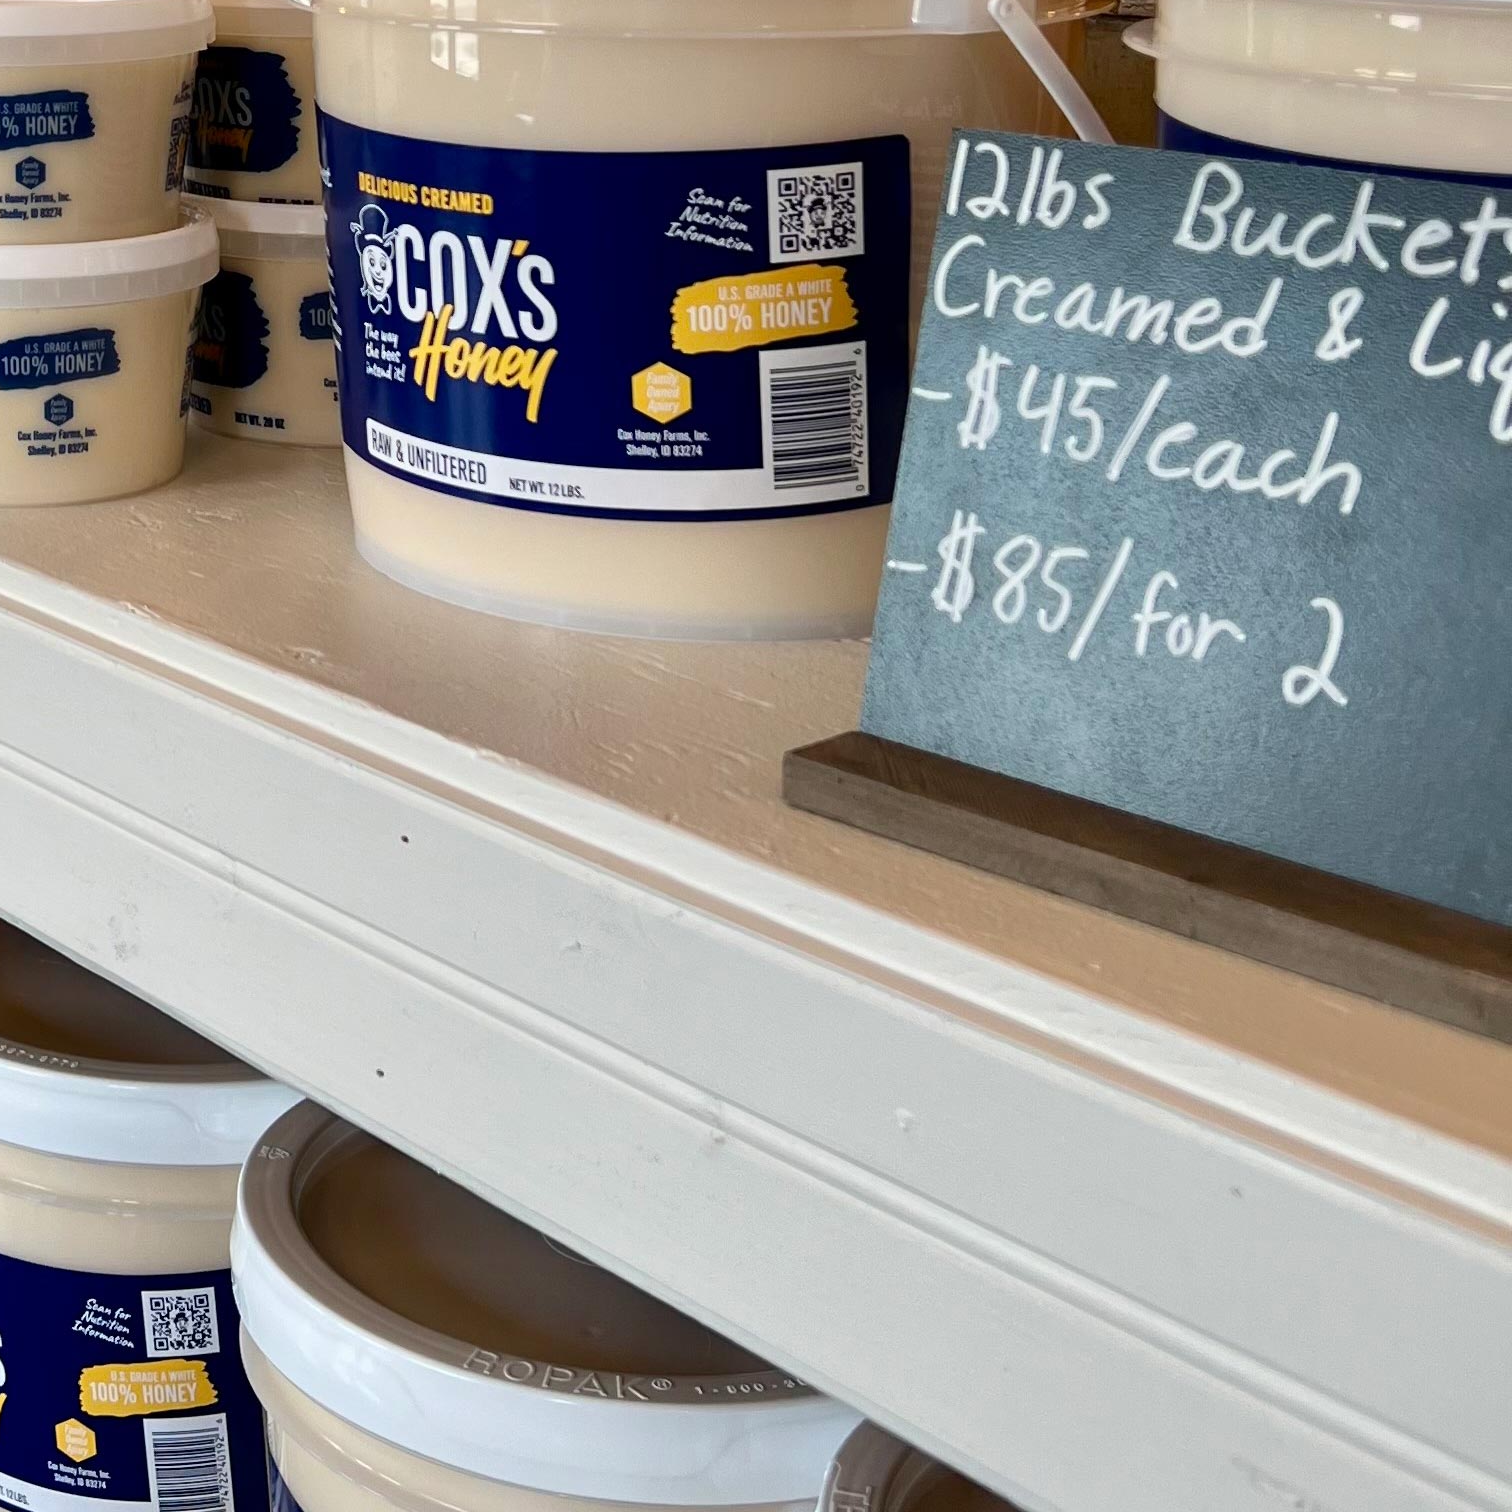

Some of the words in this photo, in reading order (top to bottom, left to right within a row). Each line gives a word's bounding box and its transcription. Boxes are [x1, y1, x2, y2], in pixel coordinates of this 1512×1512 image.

[14, 102, 42, 114] GRADE
[44, 102, 51, 114] A
[53, 101, 79, 113] WHITE
[25, 114, 79, 136] HONEY
[358, 171, 419, 206] DELICIOUS
[420, 185, 495, 216] CREAMED
[945, 138, 1115, 231] 12lbs
[686, 187, 725, 209] Scan
[727, 196, 752, 214] for
[678, 206, 749, 233] Nutrition
[664, 221, 754, 253] Information
[394, 223, 558, 343] COX'S
[718, 285, 741, 302] U.S.
[744, 283, 783, 301] GRADE
[787, 282, 794, 297] A
[796, 278, 834, 296] WHITE
[932, 233, 1285, 358] Creamed
[1315, 287, 1365, 363] &
[686, 302, 753, 333] 100%
[760, 296, 834, 330] HONEY
[24, 342, 40, 355] U.S.
[43, 341, 71, 354] GRADE
[73, 341, 80, 352] A
[81, 338, 106, 350] WHITE
[1, 355, 49, 377] 100%
[54, 351, 106, 375] HONEY
[408, 303, 559, 424] Honey
[616, 428, 634, 441] Cox
[634, 428, 662, 443] Honey
[693, 429, 712, 442] Inc.
[371, 428, 392, 458] RAW
[396, 439, 405, 463] &
[407, 442, 488, 486] UNFILTERED
[508, 476, 527, 492] NET
[528, 478, 546, 495] WT.
[548, 482, 561, 497] 12
[561, 483, 586, 500] LBS.
[1282, 596, 1349, 706] 2
[80, 1311, 131, 1335] Nutrition
[85, 1298, 112, 1316] Scan
[114, 1308, 132, 1322] for
[71, 1319, 135, 1349] Information
[169, 1369, 197, 1381] WHITE
[89, 1381, 138, 1406] 100%
[142, 1381, 199, 1405] HONEY
